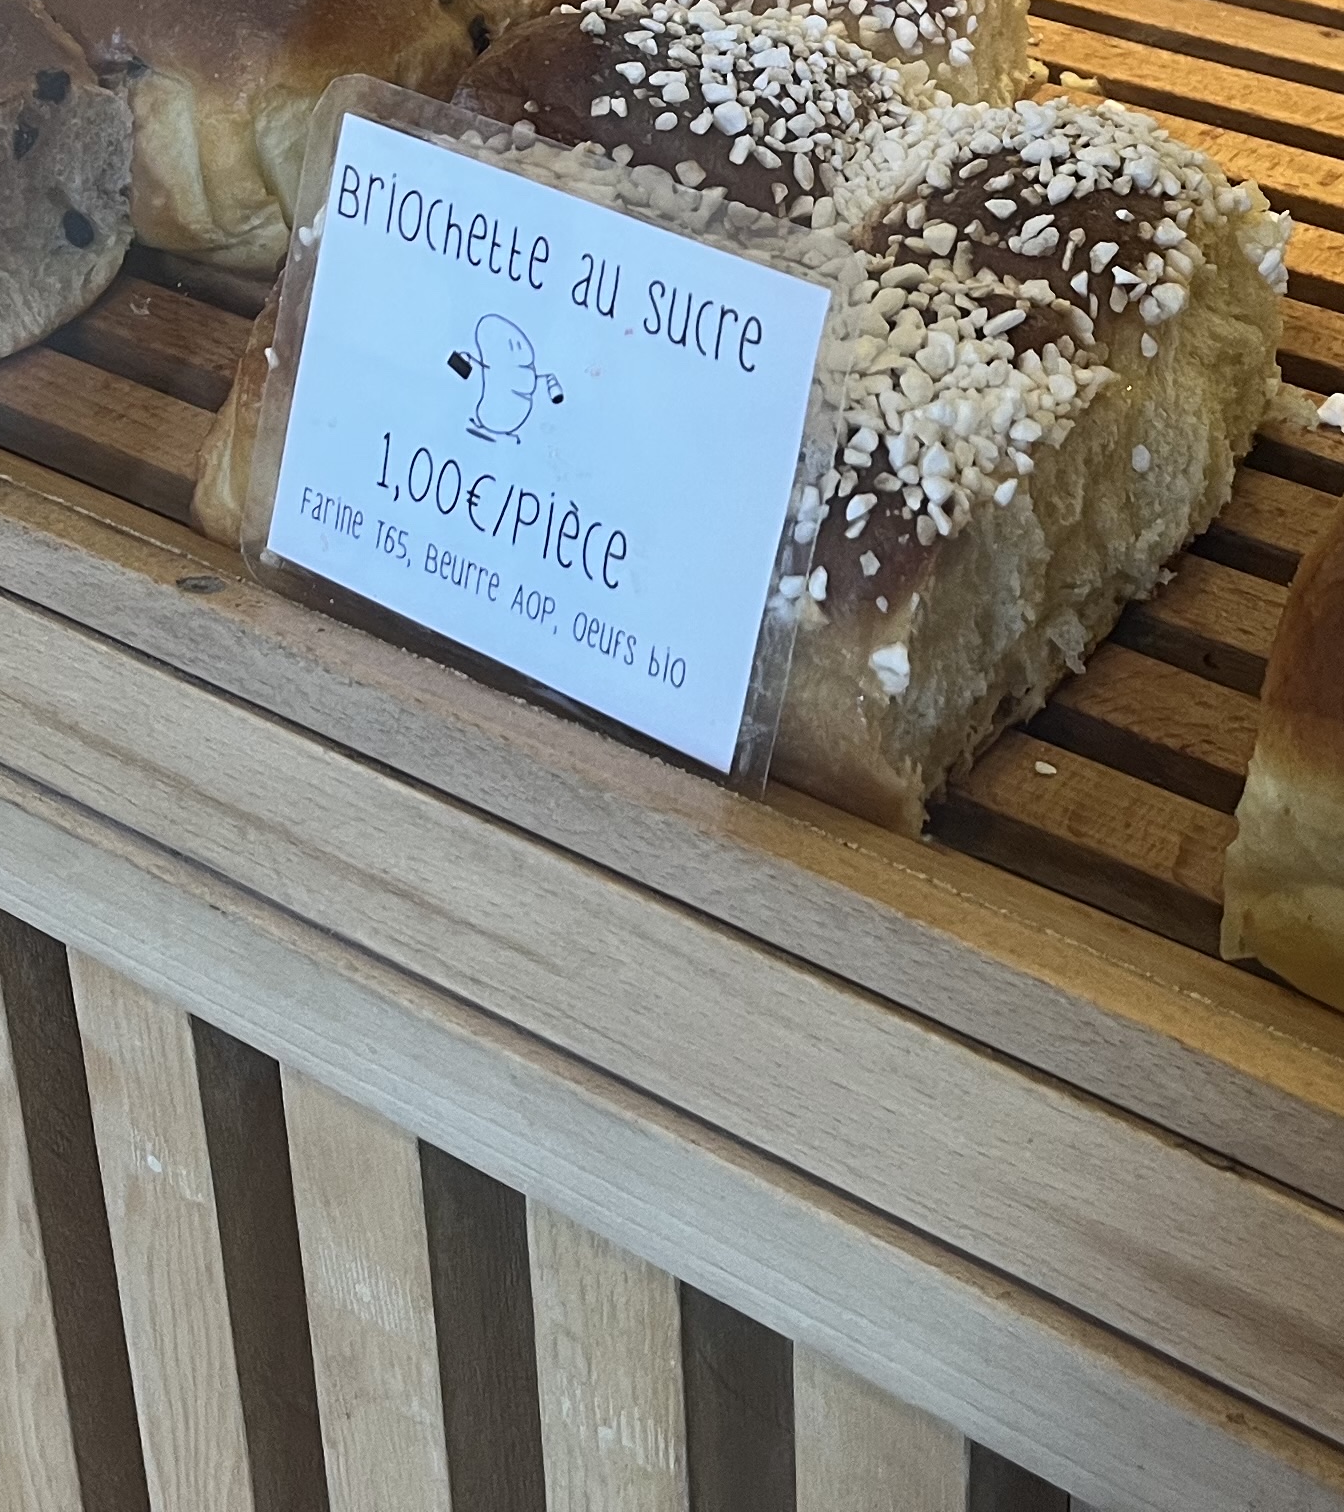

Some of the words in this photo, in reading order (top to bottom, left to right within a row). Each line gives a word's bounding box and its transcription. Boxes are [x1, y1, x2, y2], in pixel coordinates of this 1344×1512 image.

[337, 164, 551, 290] Briochette
[571, 252, 621, 319] au
[643, 279, 763, 373] sucre
[300, 486, 364, 539] Farine
[376, 519, 412, 568] T65,
[424, 542, 500, 602] Beurre
[510, 584, 558, 635] AOP,
